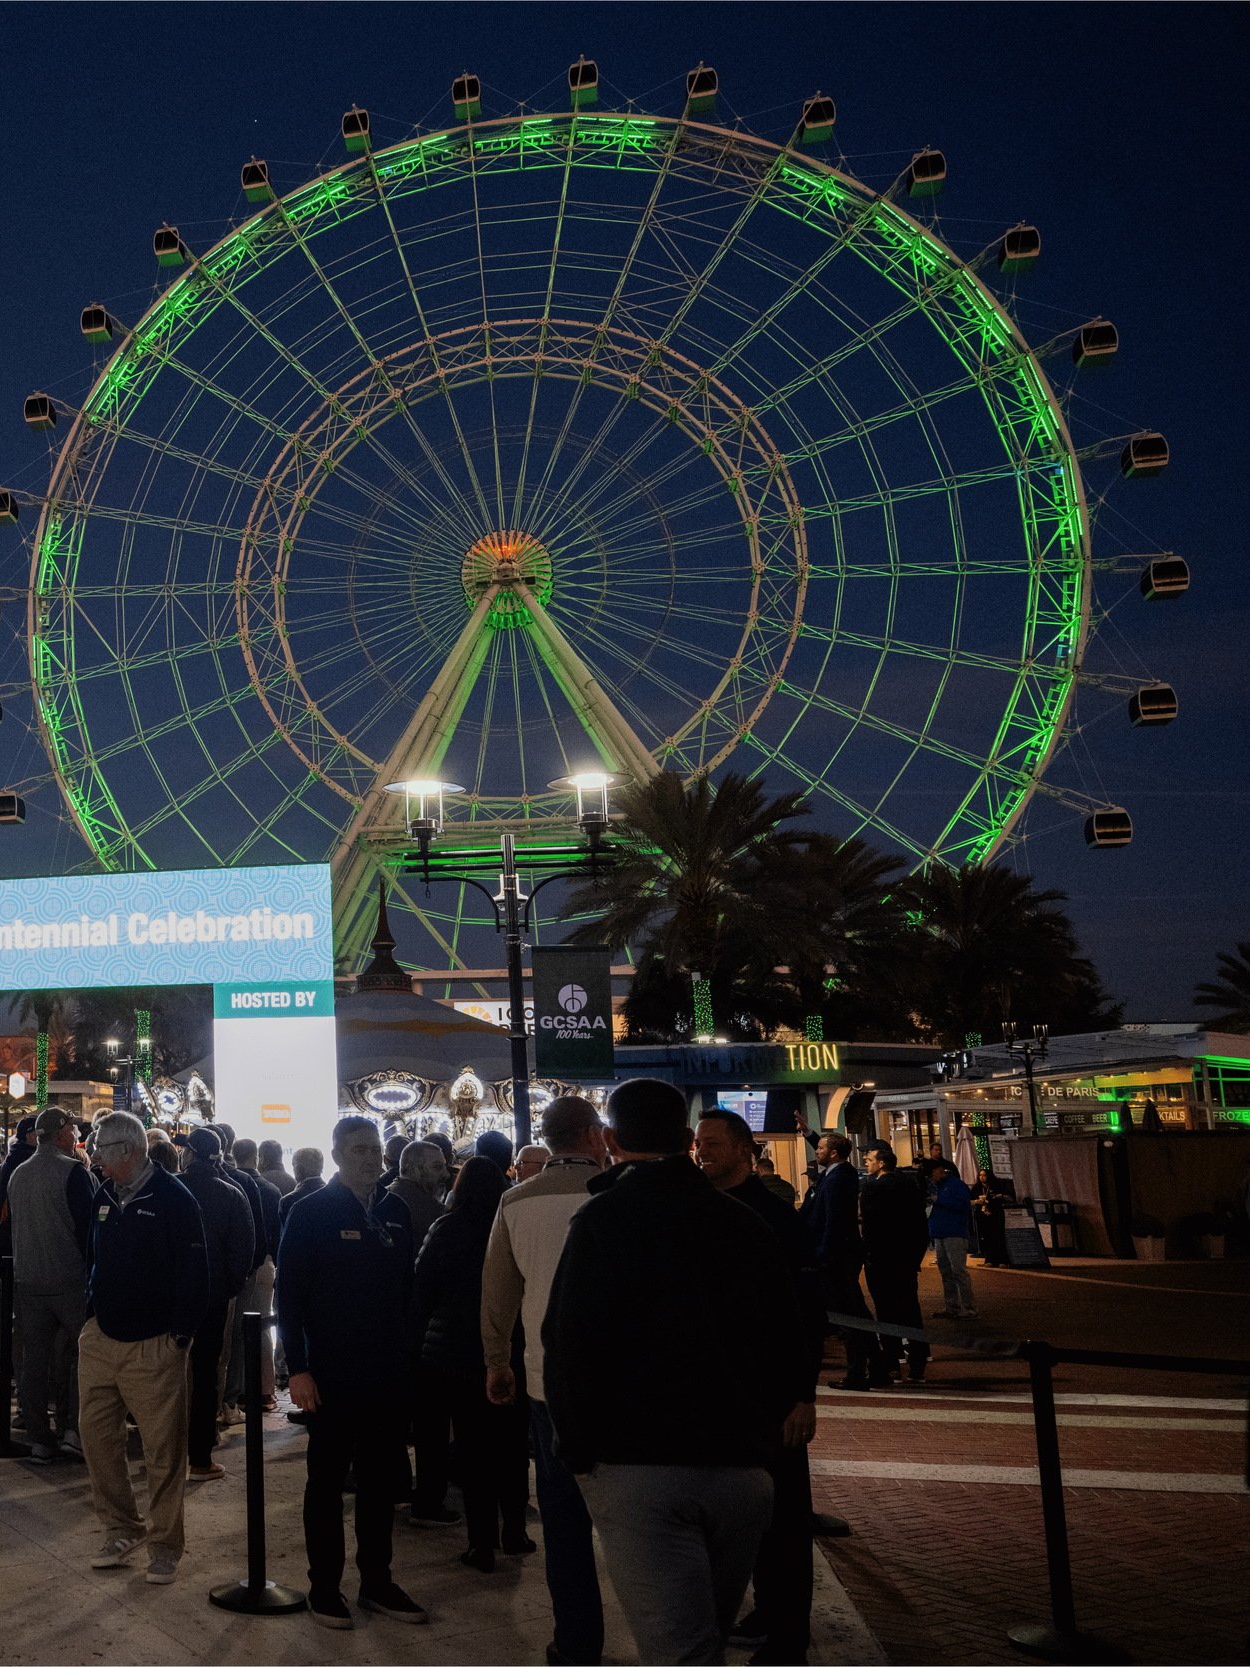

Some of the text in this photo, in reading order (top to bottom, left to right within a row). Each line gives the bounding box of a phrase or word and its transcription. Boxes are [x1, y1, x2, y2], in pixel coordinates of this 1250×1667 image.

[128, 907, 314, 944] Celebration
[231, 991, 316, 1008] HOSTED BY
[539, 1015, 607, 1030] GCSAA
[555, 1029, 591, 1040] 100 Years
[1047, 1086, 1063, 1097] DE
[1066, 1086, 1100, 1097] PARIS
[1091, 1113, 1108, 1123] BEER
[1158, 1111, 1186, 1121] KTAILS
[1212, 1111, 1250, 1121] FROZE
